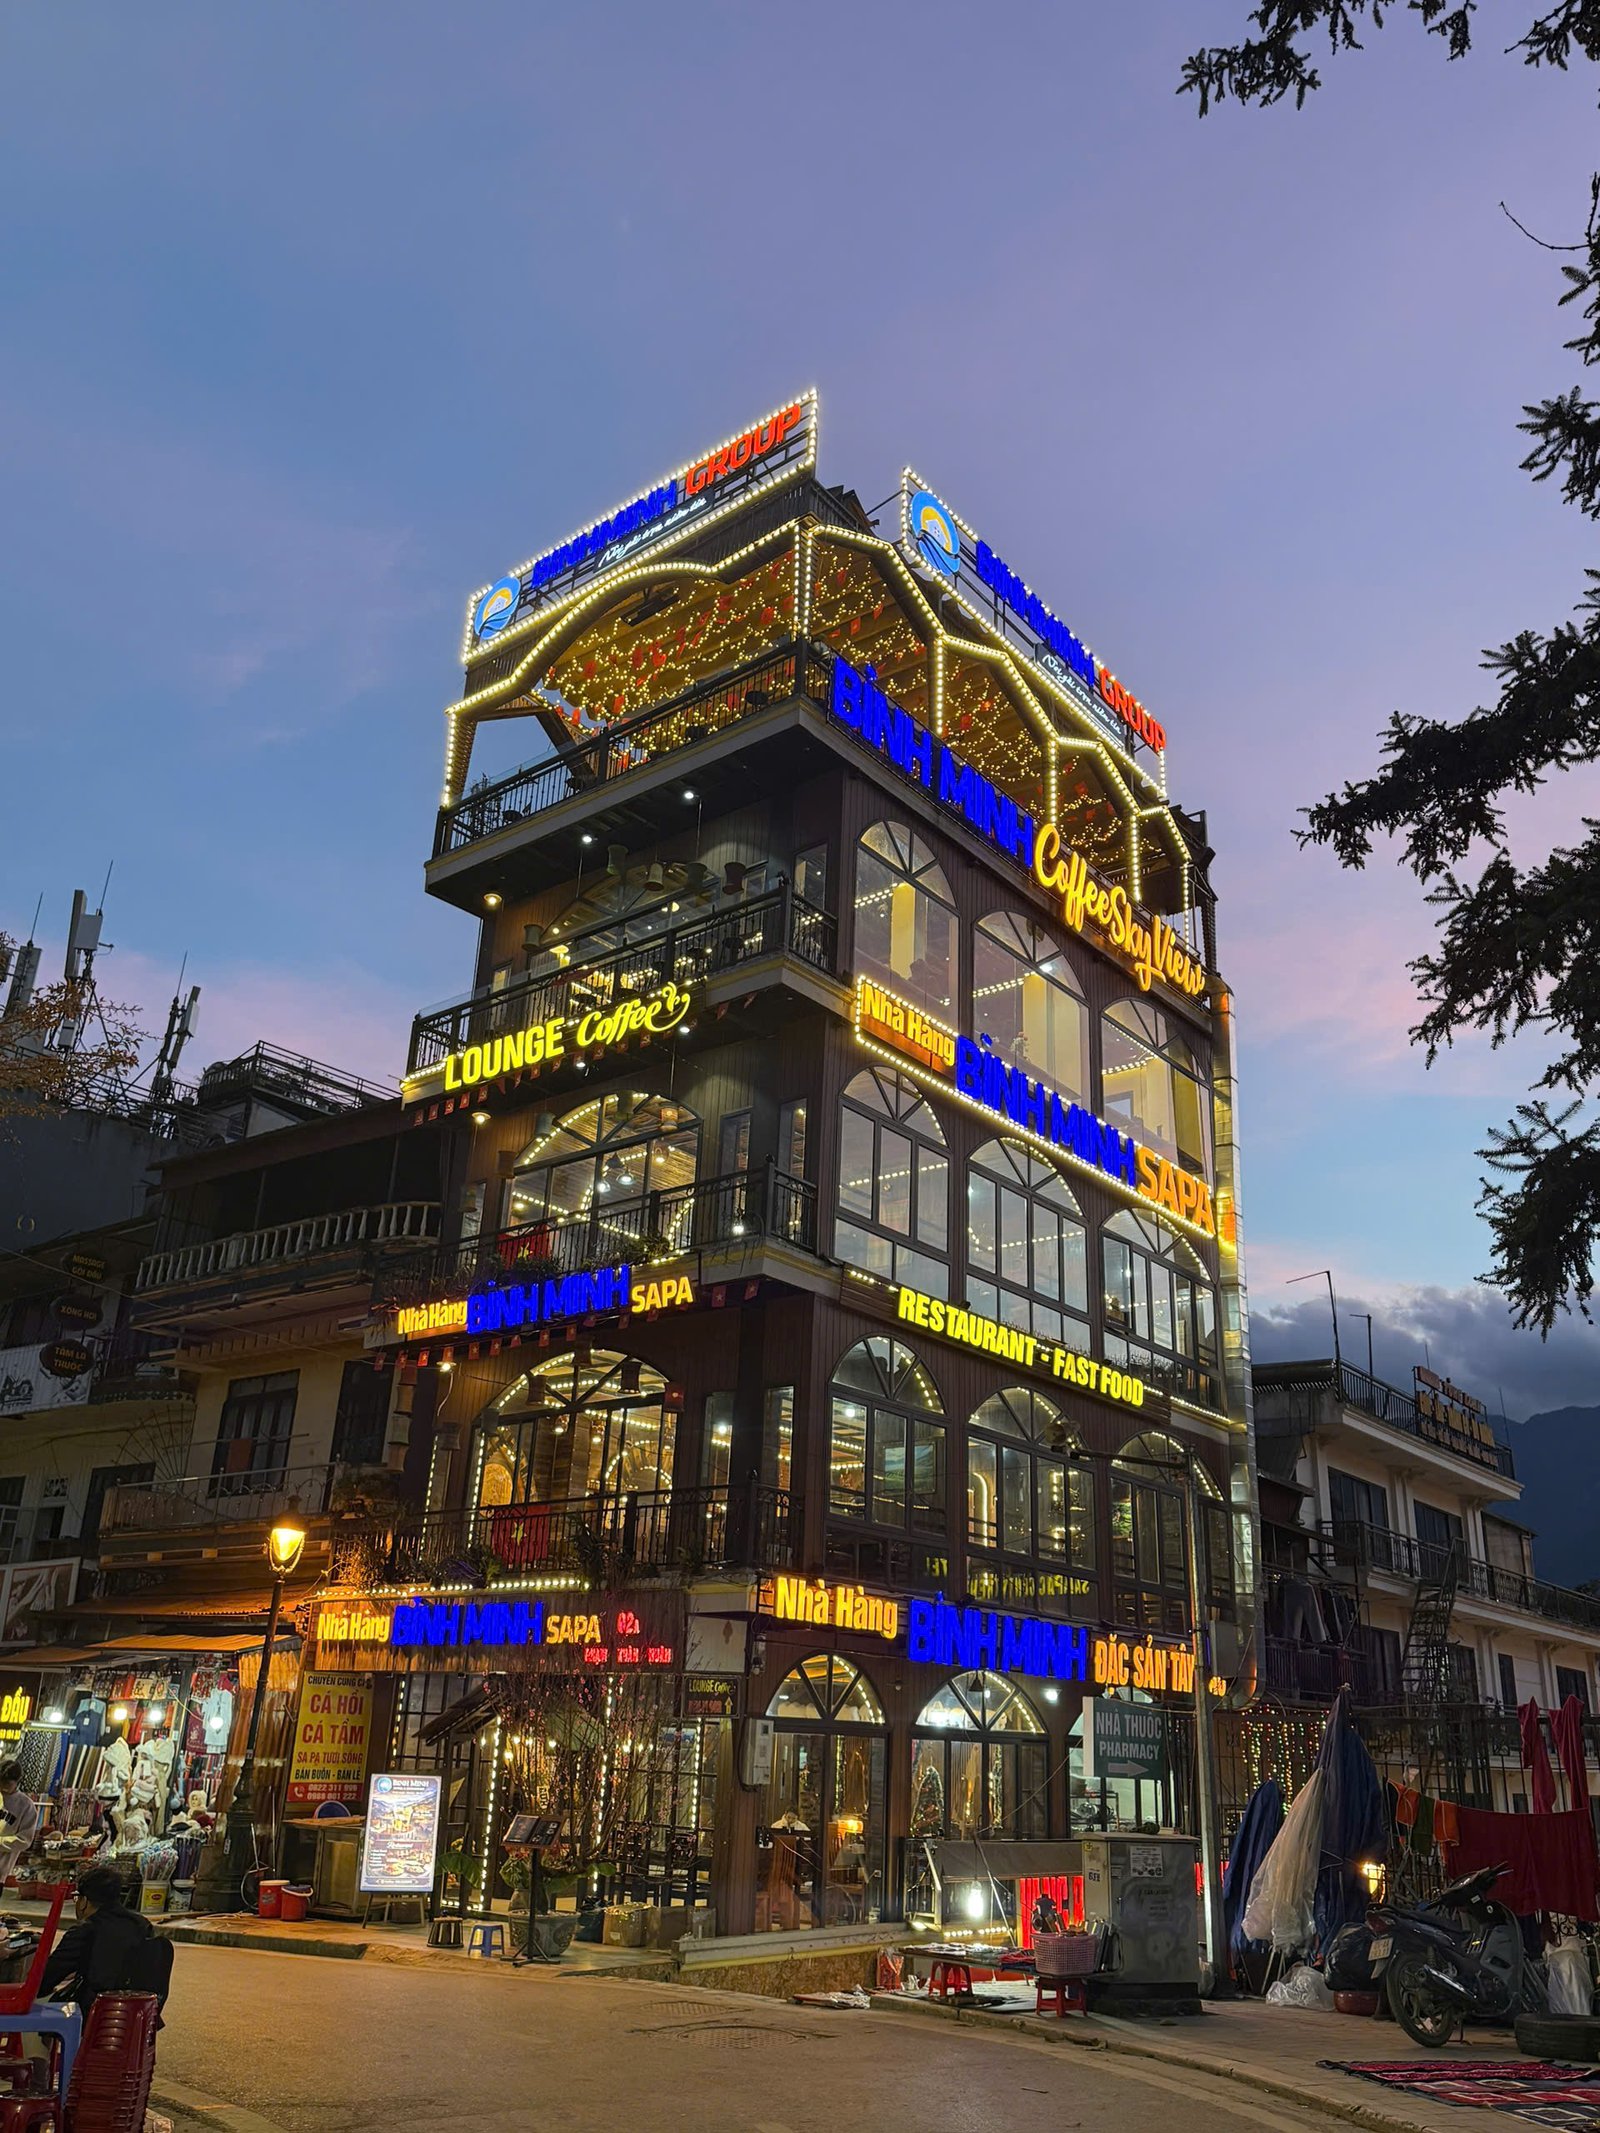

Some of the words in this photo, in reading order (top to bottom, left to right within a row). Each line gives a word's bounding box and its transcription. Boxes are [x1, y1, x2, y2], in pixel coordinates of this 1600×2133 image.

[686, 404, 802, 496] GROUP
[1100, 666, 1167, 753] GROUP
[832, 656, 932, 789] BÌNH
[939, 745, 1035, 869] MINH
[444, 1016, 566, 1092] LOUNGE
[576, 993, 692, 1047] Coffee
[955, 1032, 1046, 1140] BÌNH
[1050, 1091, 1137, 1190] MINH
[1137, 1146, 1215, 1236] SAPA
[467, 1280, 540, 1334] BÌNH
[542, 1263, 631, 1319] MINH
[631, 1275, 695, 1314] SAPA
[897, 1286, 1039, 1367] RESTAURANT
[1053, 1346, 1101, 1390] FAST
[1100, 1366, 1145, 1408] FOOD
[391, 1596, 459, 1645] BÌNH
[461, 1602, 544, 1645] MINH
[546, 1615, 602, 1644] SAPA
[777, 1576, 829, 1624] Nhà
[836, 1585, 898, 1639] Hàng
[907, 1592, 998, 1669] BÌNH
[1002, 1616, 1087, 1680] MINH
[1094, 1632, 1130, 1696] ĐẶC
[1133, 1634, 1168, 1690] SẢN
[1169, 1642, 1196, 1693] TÂY
[310, 1690, 332, 1714] CÁ
[336, 1688, 364, 1715] HỒI
[689, 1679, 715, 1693] LOUNGE
[297, 1751, 308, 1763] SA
[302, 1720, 324, 1744] CÁ
[329, 1718, 365, 1745] TẦM
[1099, 1741, 1160, 1761] PHARMACY
